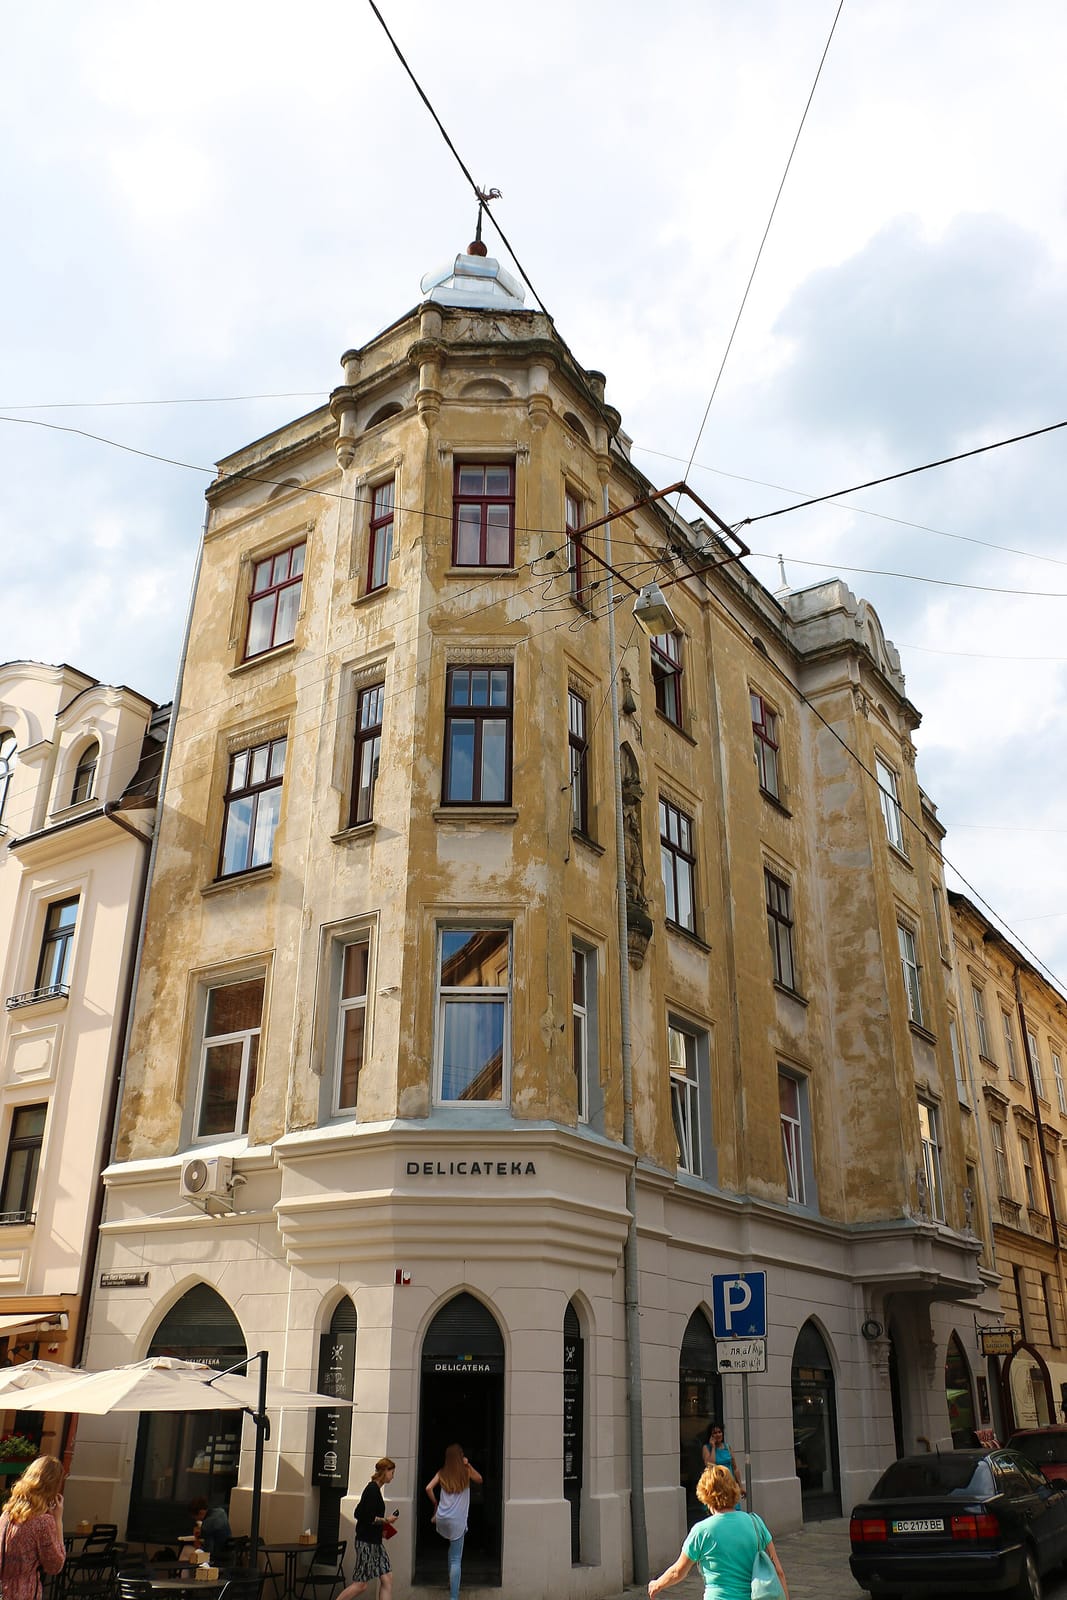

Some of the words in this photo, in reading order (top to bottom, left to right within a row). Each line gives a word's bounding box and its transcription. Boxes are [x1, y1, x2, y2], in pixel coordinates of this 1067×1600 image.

[406, 1161, 537, 1176] DELICATEKA
[723, 1279, 752, 1330] P
[434, 1363, 490, 1372] DELICATEKA
[897, 1522, 909, 1530] BC
[910, 1521, 928, 1530] 2173
[929, 1520, 942, 1530] BE
